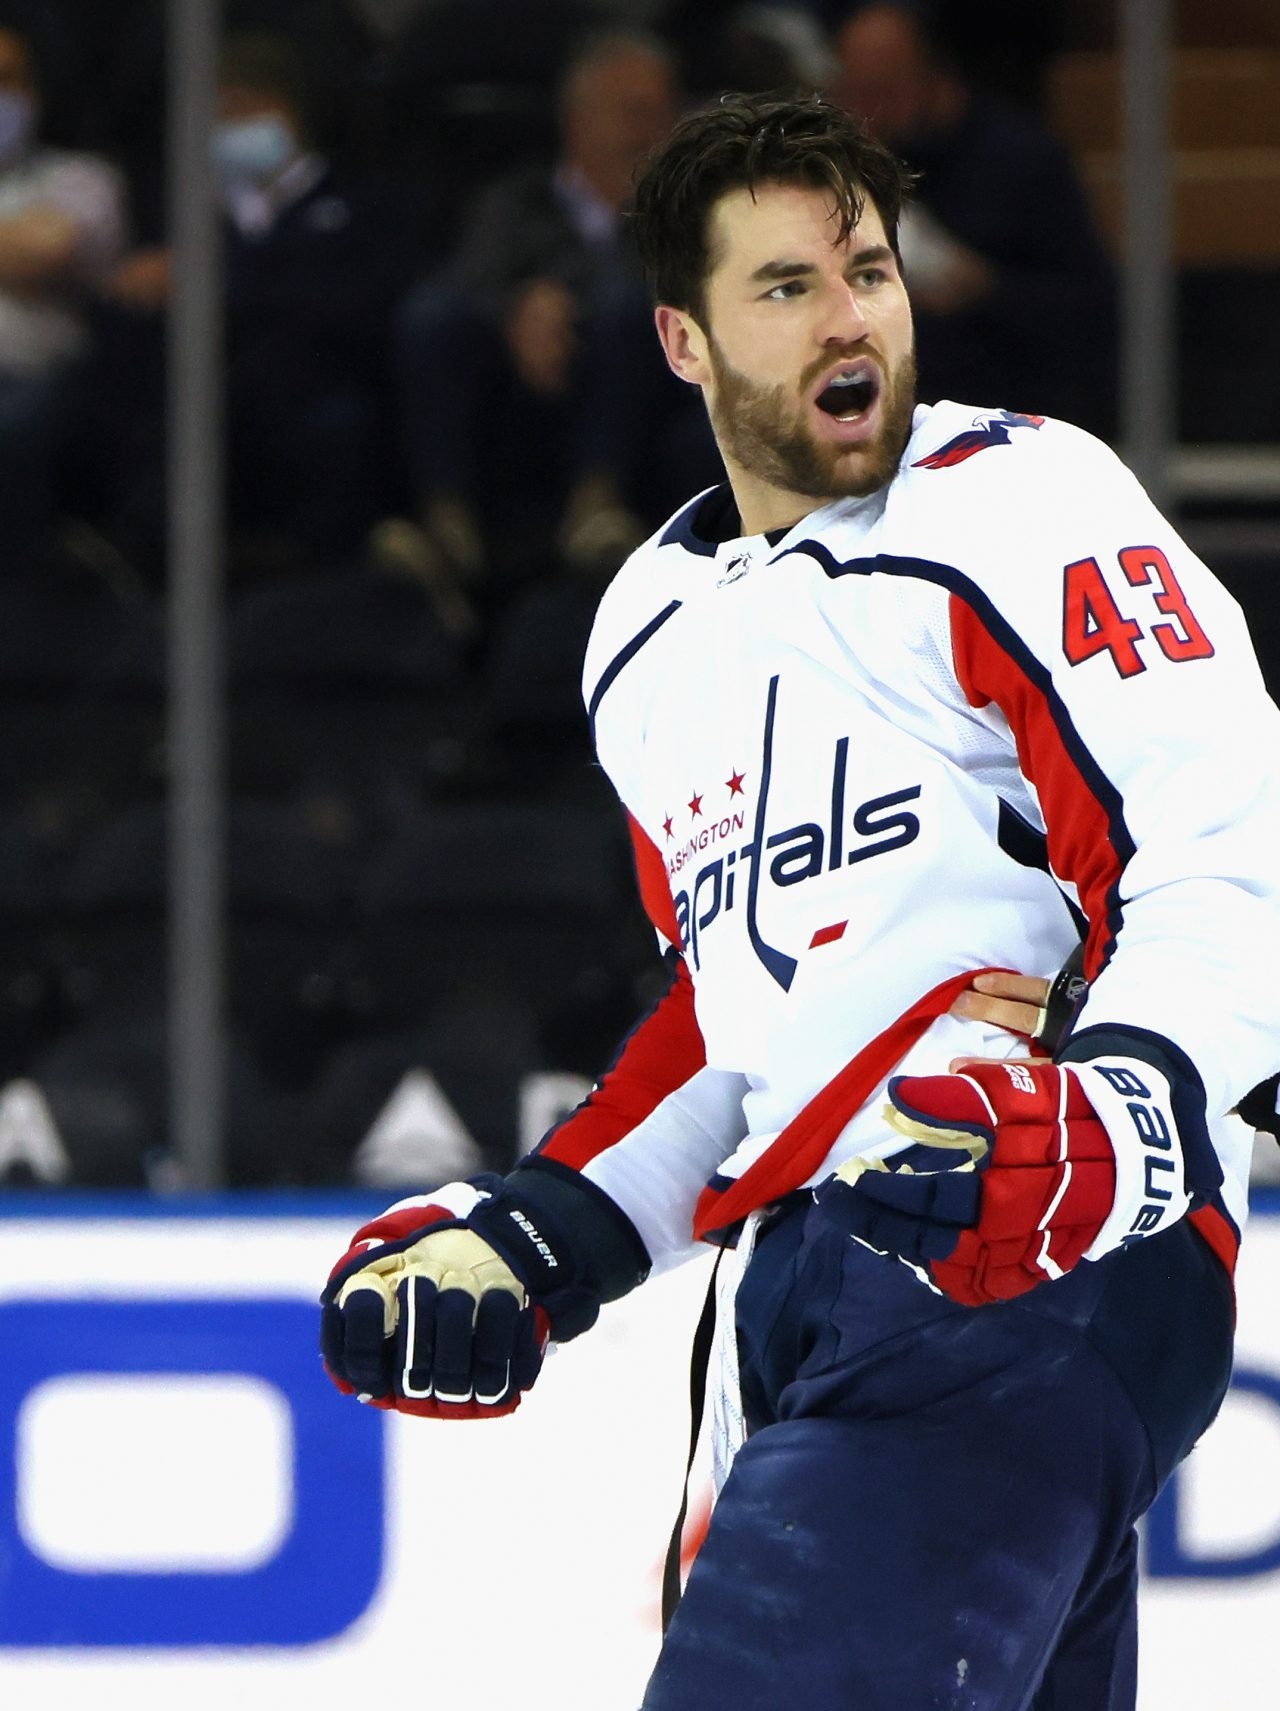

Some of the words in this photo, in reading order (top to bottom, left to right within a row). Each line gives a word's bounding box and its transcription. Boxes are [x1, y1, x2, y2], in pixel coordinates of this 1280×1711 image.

[1062, 546, 1215, 680] 43
[667, 810, 744, 877] ASHINGTON
[673, 674, 921, 993] apitals
[1092, 1065, 1175, 1243] BAUE
